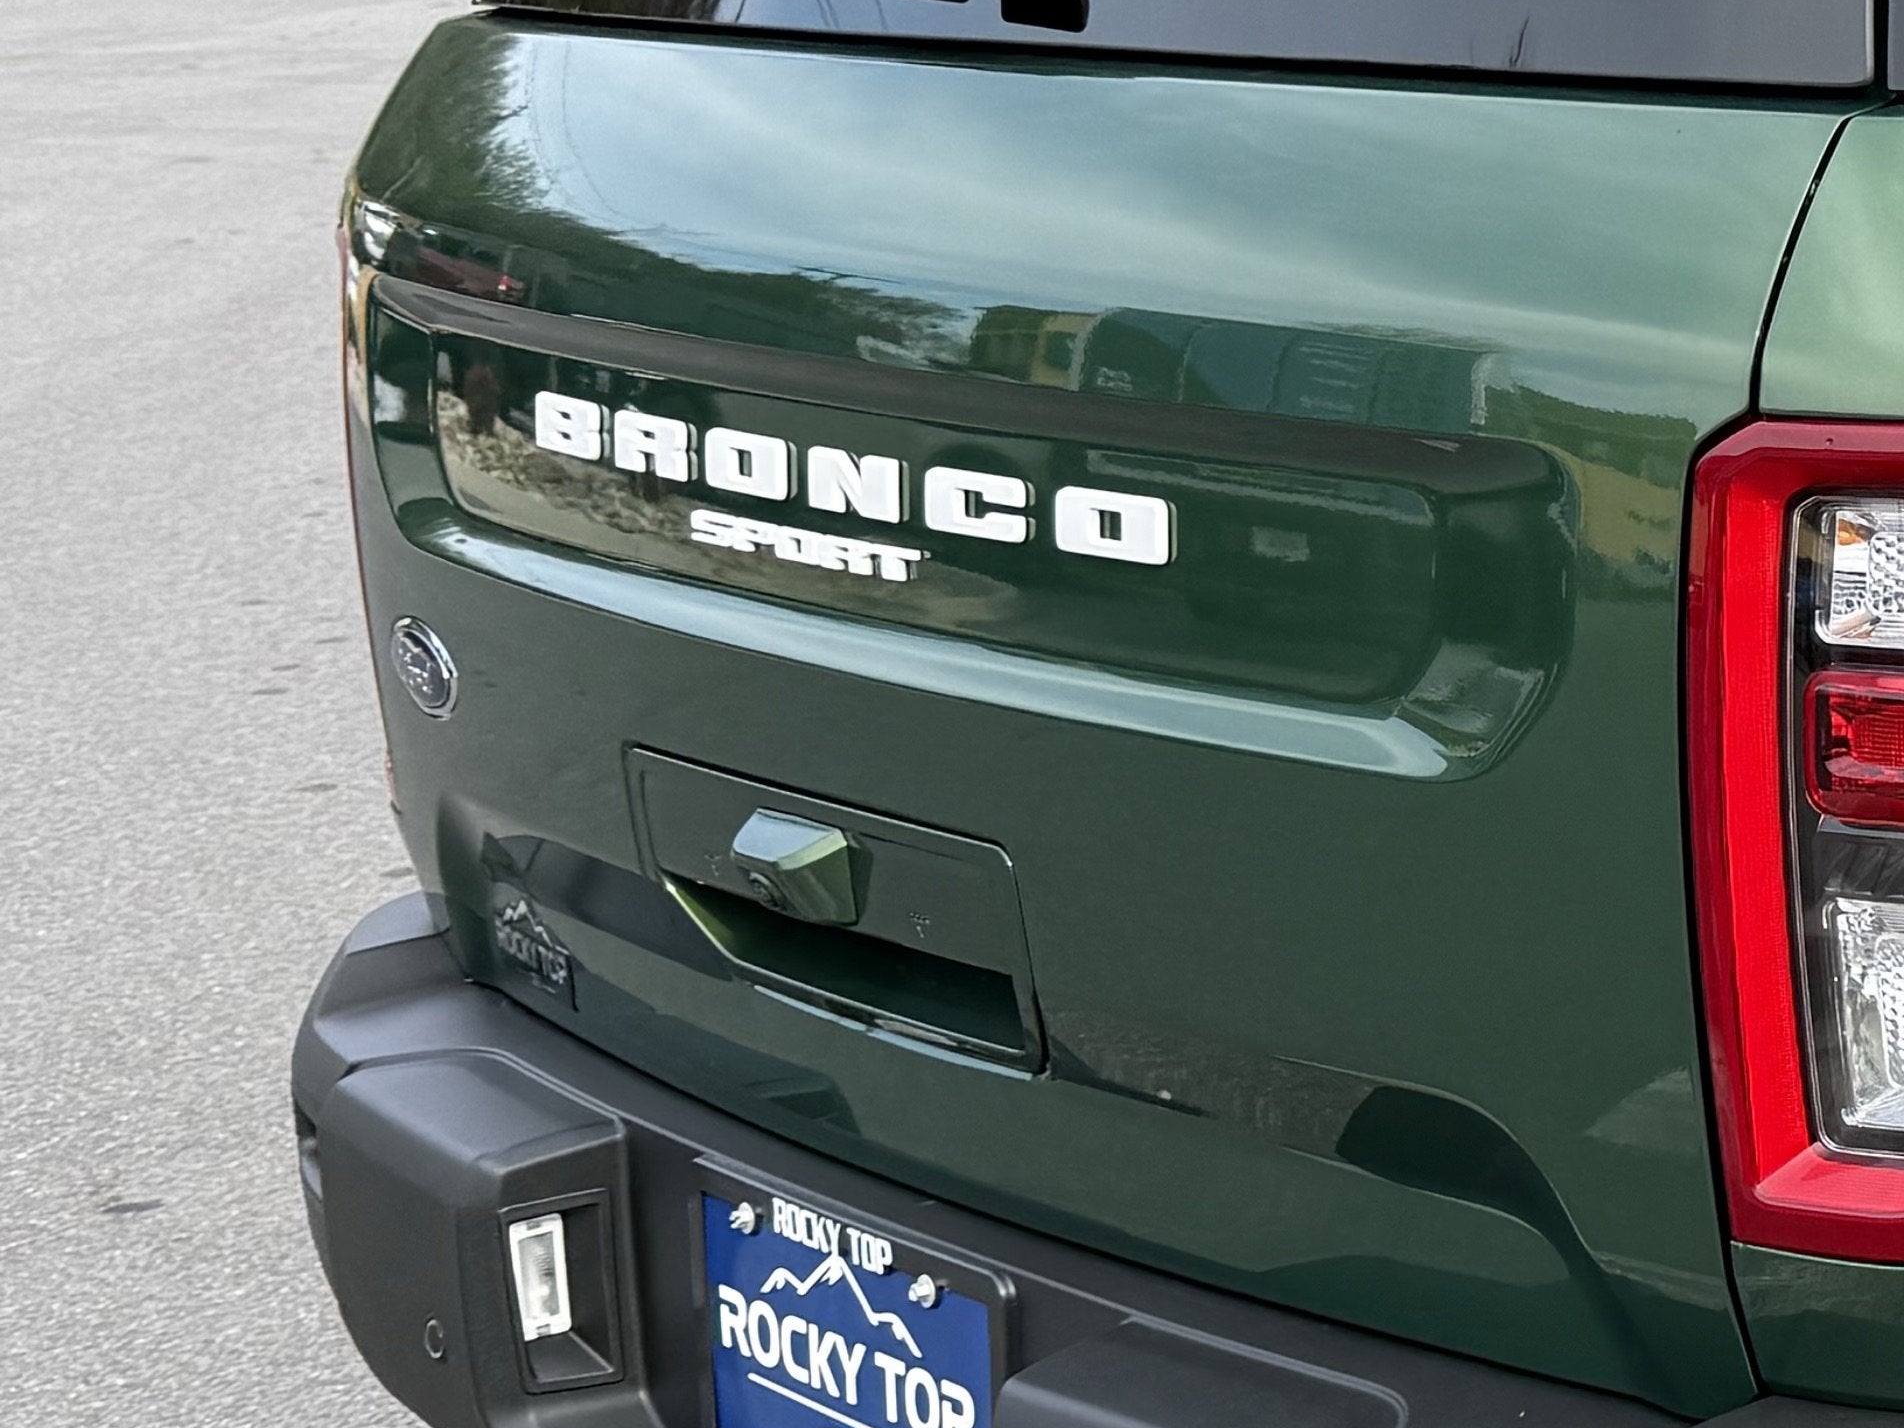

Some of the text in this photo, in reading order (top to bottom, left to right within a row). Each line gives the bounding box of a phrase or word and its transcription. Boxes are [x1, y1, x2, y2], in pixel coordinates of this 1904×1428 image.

[534, 389, 1179, 567] BRONCO
[690, 507, 930, 582] SPORT
[772, 1196, 894, 1275] ROCKY TOP
[718, 1284, 867, 1406] ROCKY
